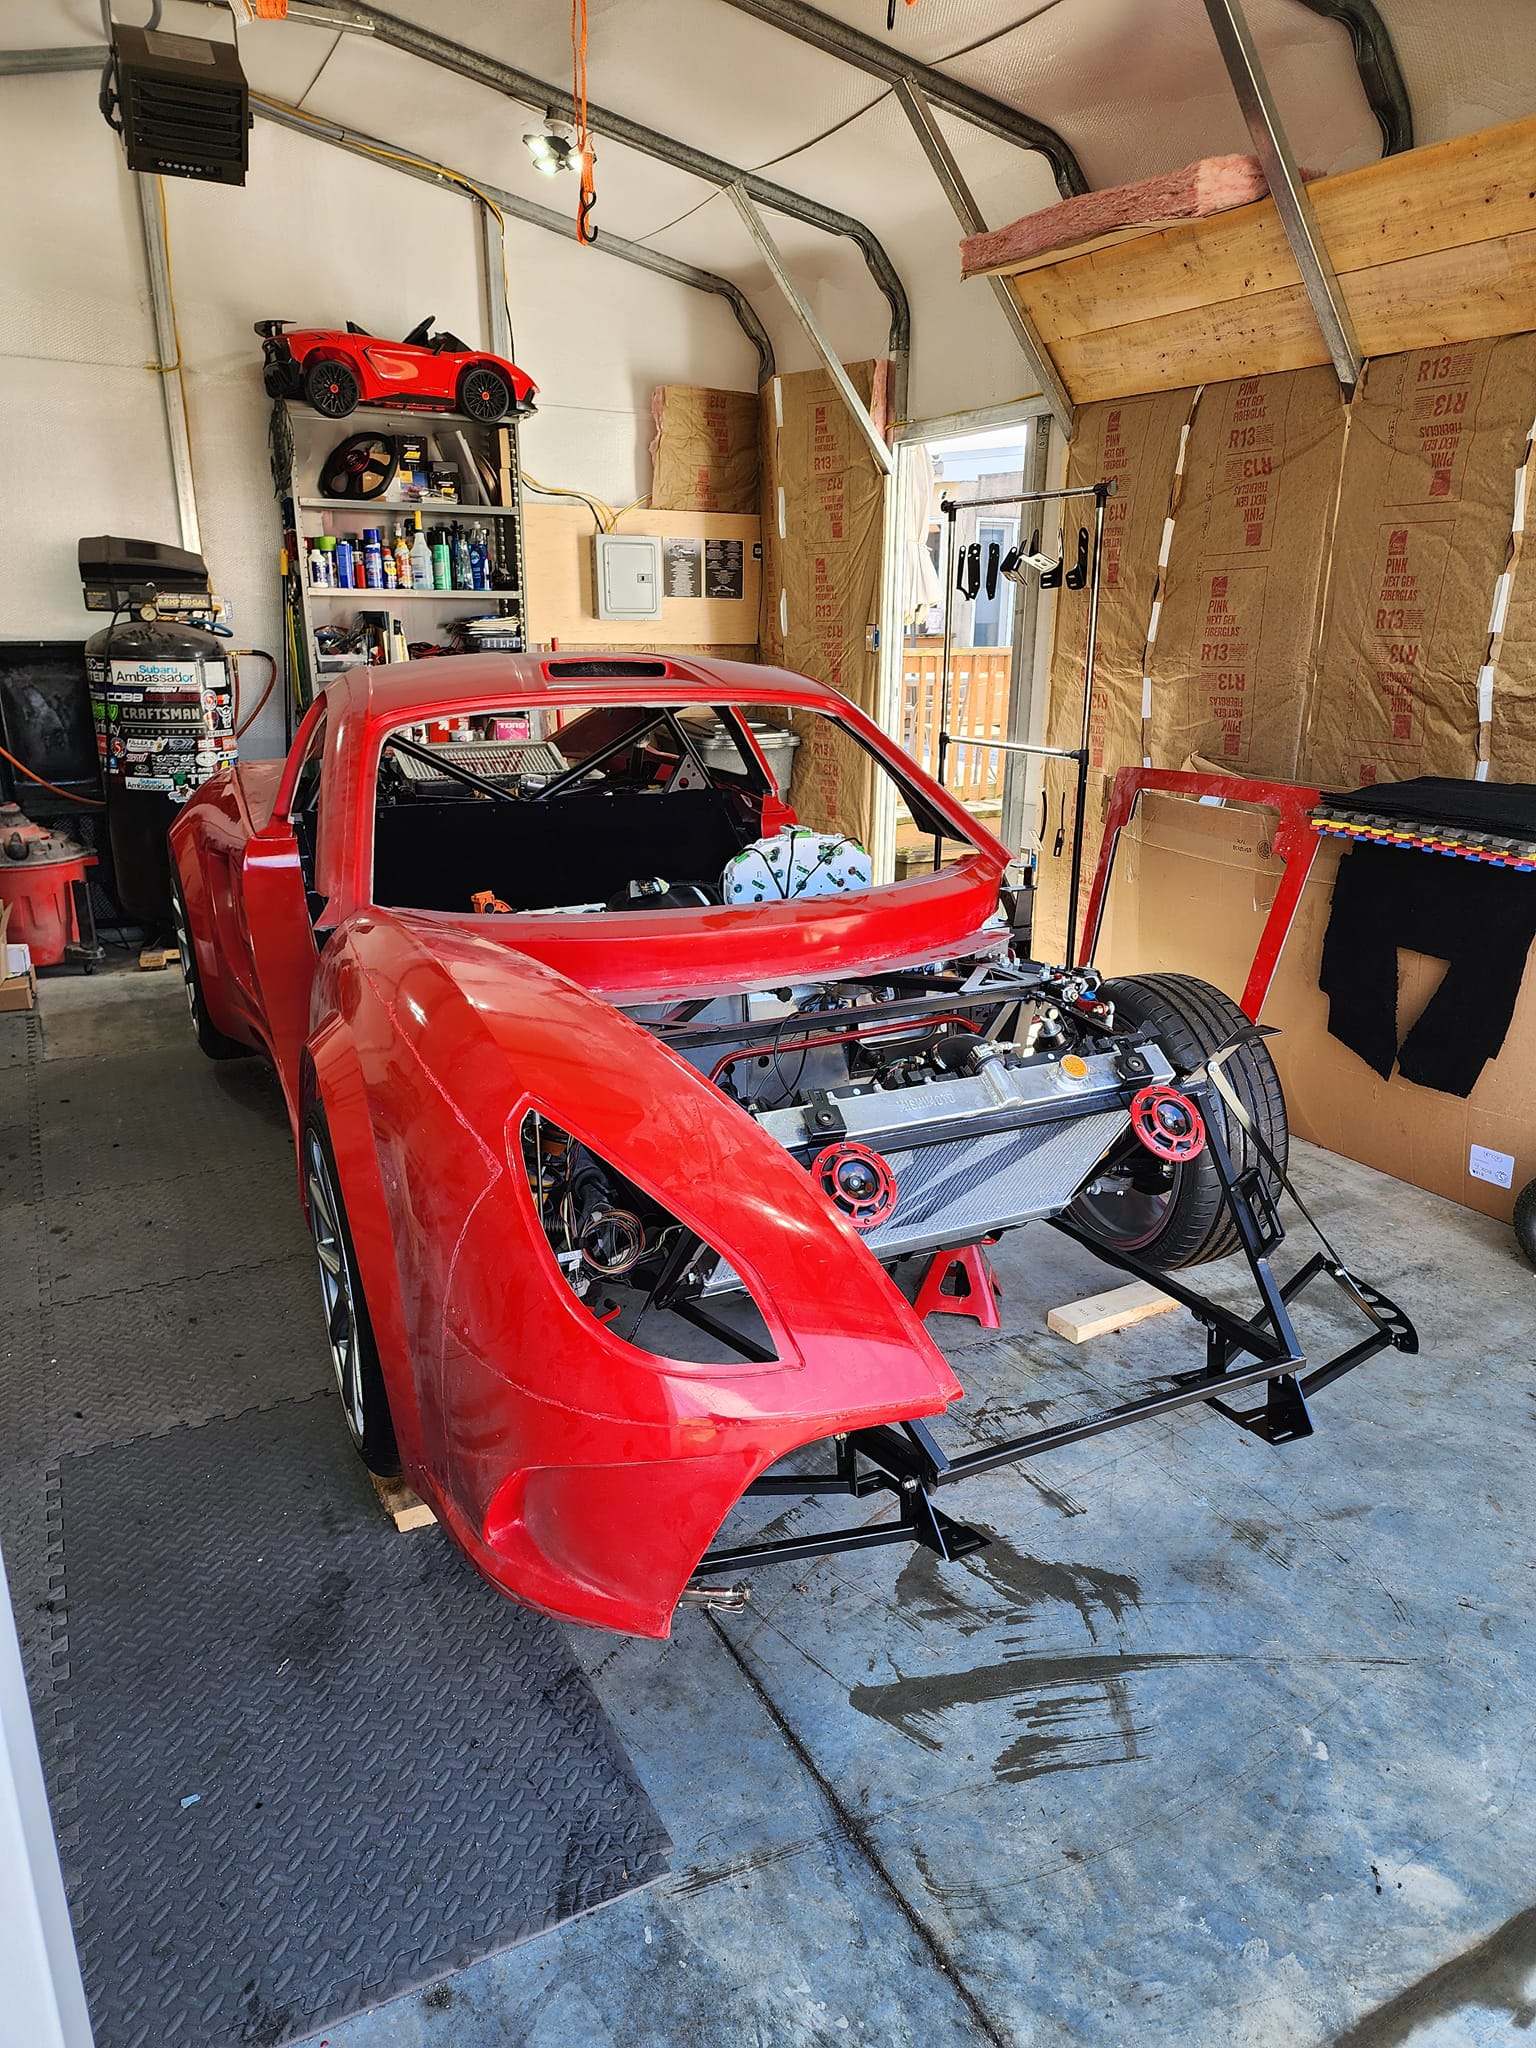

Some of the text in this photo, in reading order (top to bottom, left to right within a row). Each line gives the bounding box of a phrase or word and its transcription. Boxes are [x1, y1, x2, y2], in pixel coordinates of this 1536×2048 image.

[1417, 356, 1453, 382] R13
[1238, 380, 1261, 396] PINK
[1433, 392, 1469, 417] R13
[1229, 427, 1256, 448] R13
[1438, 437, 1460, 450] NEXT
[815, 456, 831, 470] R13
[1431, 451, 1456, 469] PINK
[1243, 457, 1273, 478] R13
[1108, 503, 1127, 521] R13
[1243, 507, 1266, 522] PINK
[1385, 558, 1408, 574] PINK
[1383, 576, 1416, 588] NEXT GEN
[1380, 589, 1418, 600] FIBERGLAS
[816, 605, 832, 617] R13
[1208, 600, 1229, 613] PINK
[1206, 615, 1237, 625] NEXT GEN
[1376, 608, 1405, 629] R13
[1204, 627, 1240, 637] FIBERGLAS
[1200, 643, 1229, 661] R13
[1389, 643, 1419, 665] R13
[139, 664, 178, 674] Subaru
[116, 671, 194, 682] Ambassador
[1218, 673, 1246, 691] R13
[107, 692, 144, 703] COBB
[122, 707, 200, 720] CRAFTSMAN
[1221, 720, 1242, 733] PINK
